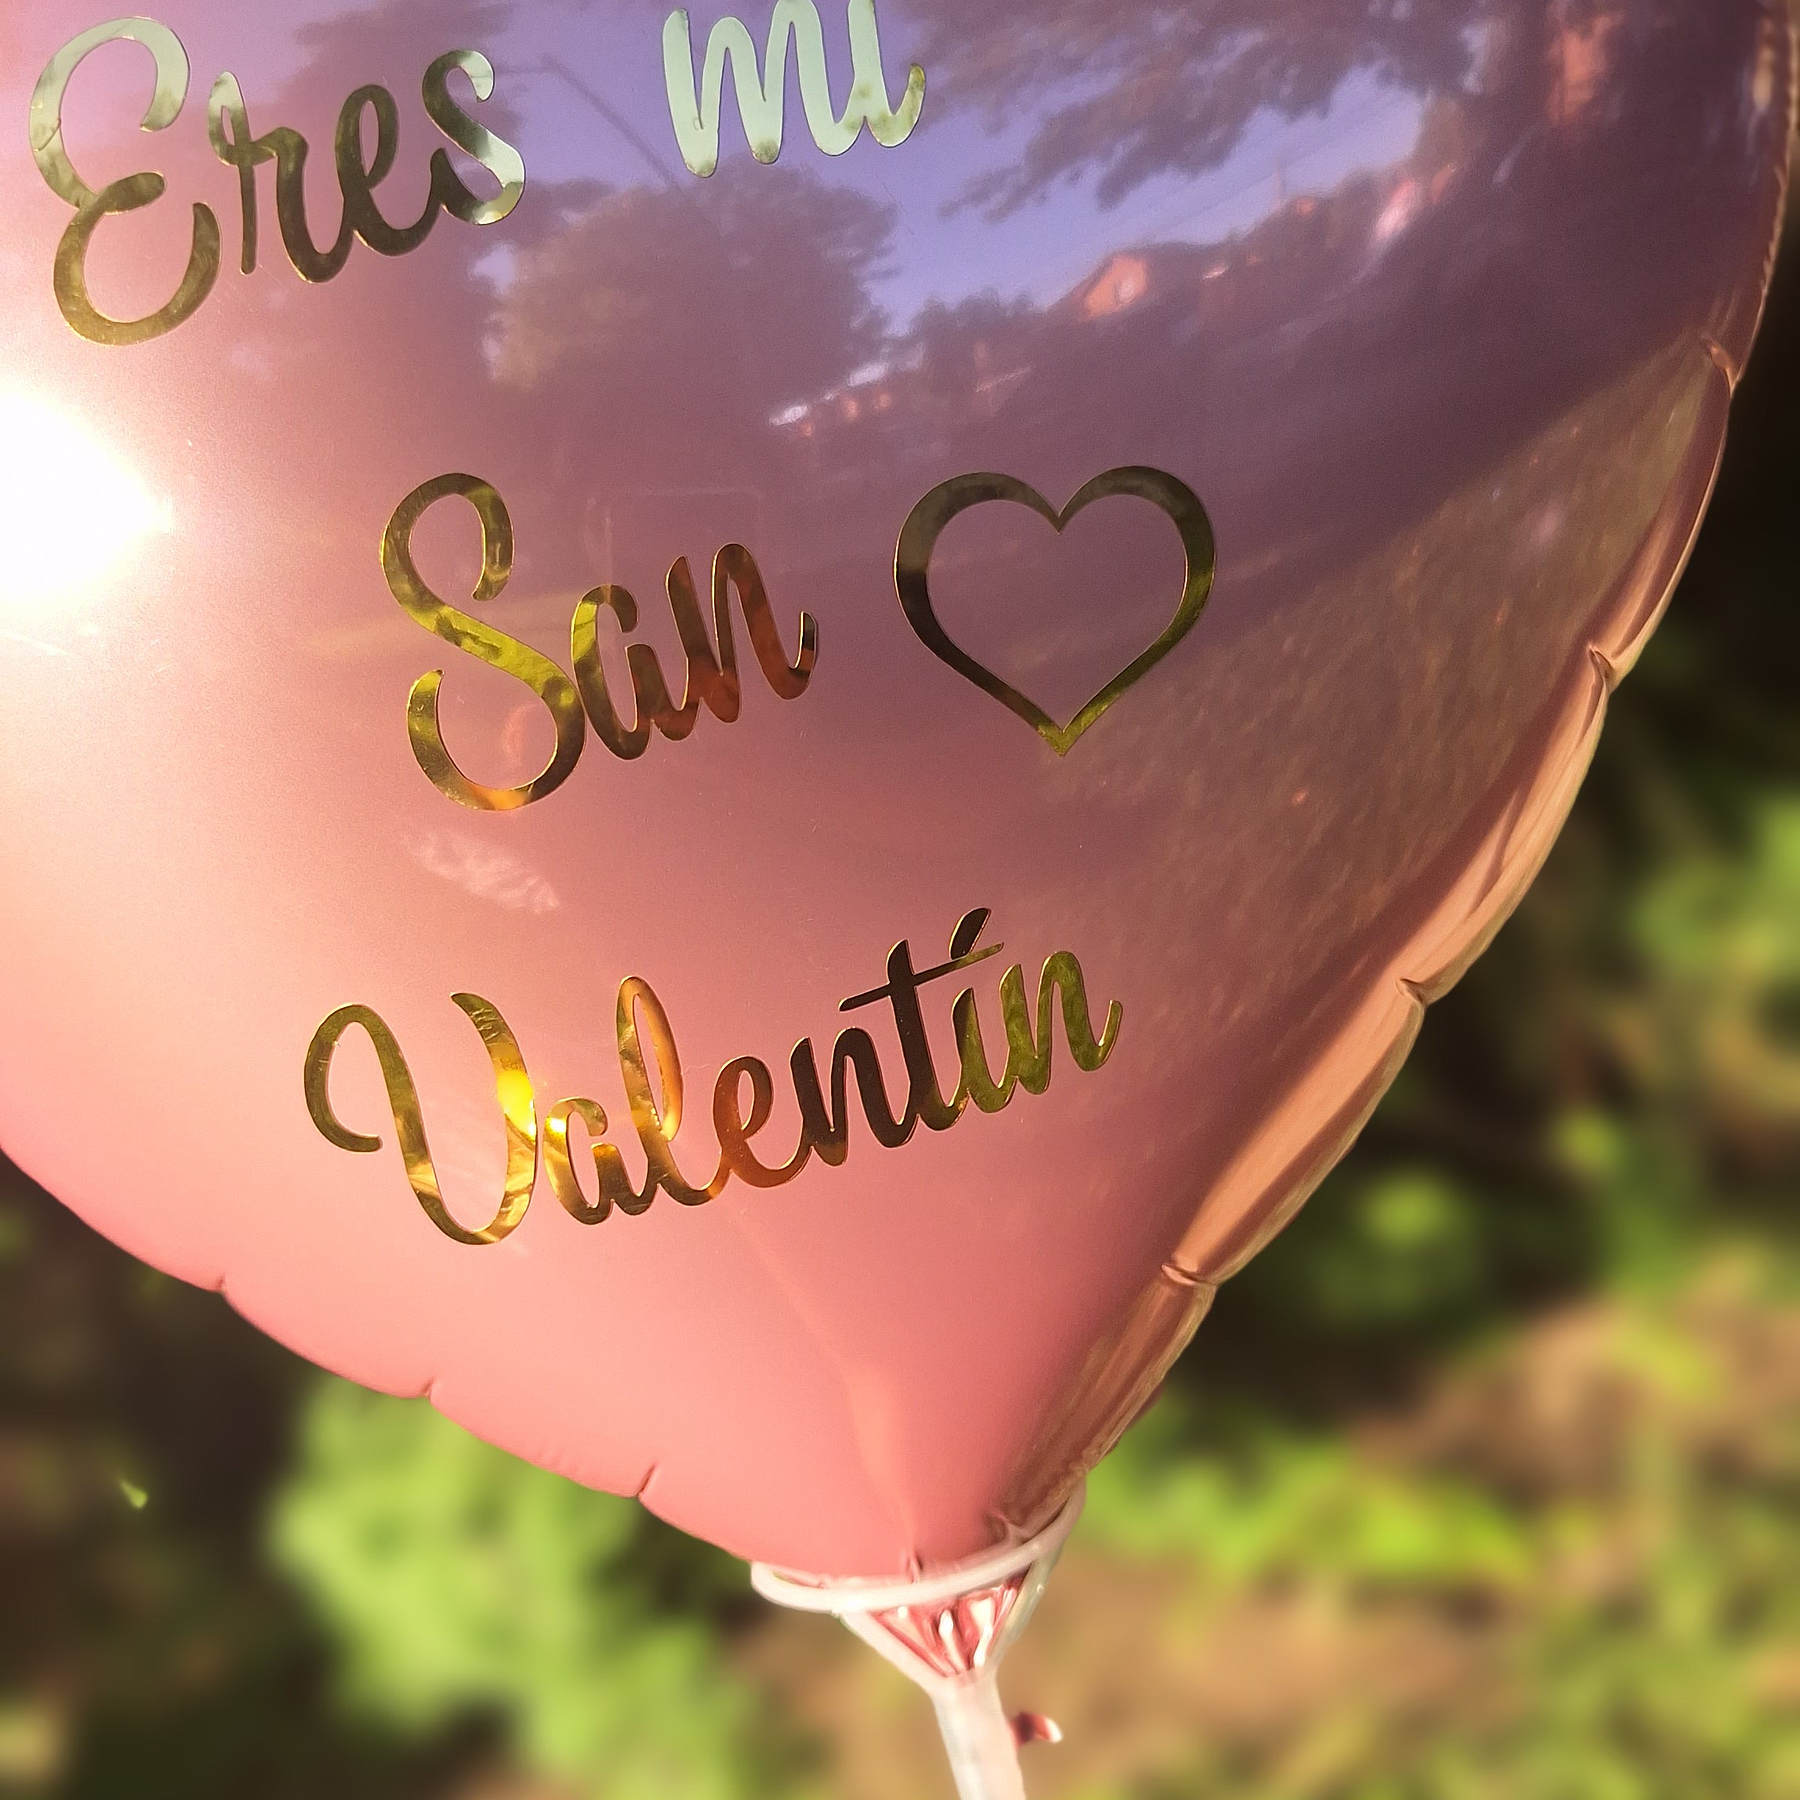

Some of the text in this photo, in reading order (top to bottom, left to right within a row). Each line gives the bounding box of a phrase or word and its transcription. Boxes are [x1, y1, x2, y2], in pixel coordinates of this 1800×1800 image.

[29, 0, 926, 346] Eres mi
[379, 472, 819, 812] San
[303, 907, 1123, 1245] Valentín
